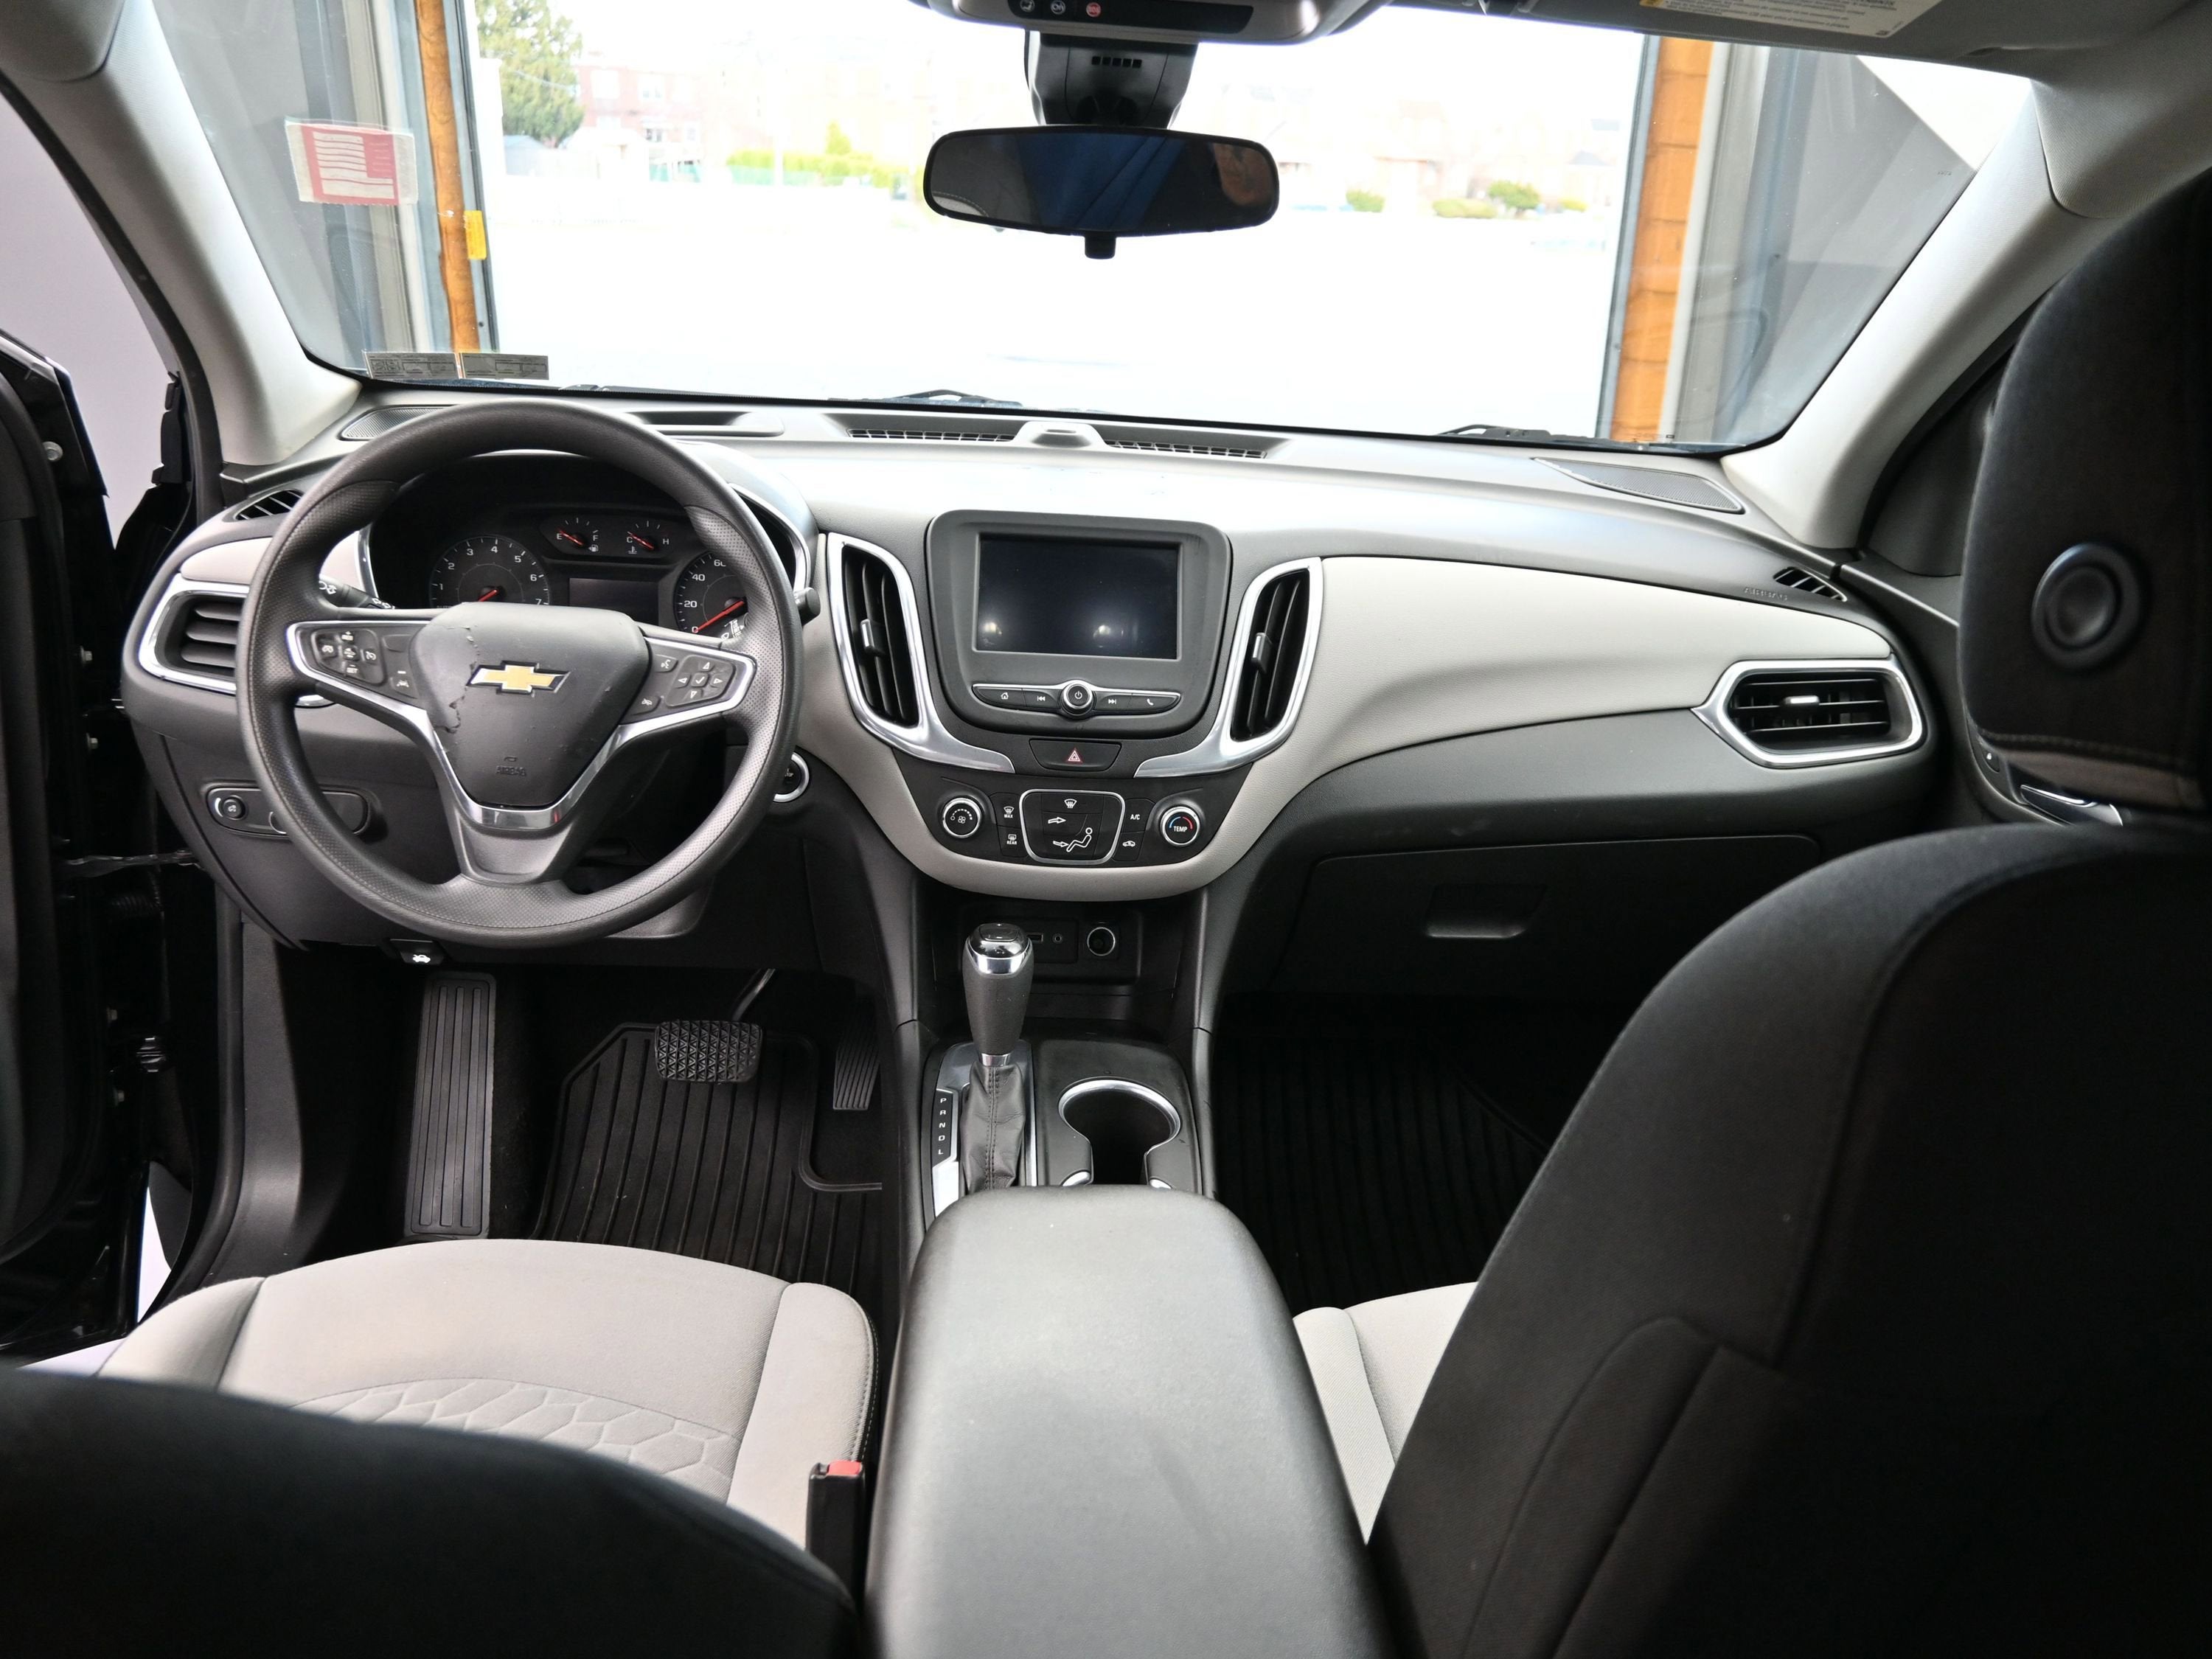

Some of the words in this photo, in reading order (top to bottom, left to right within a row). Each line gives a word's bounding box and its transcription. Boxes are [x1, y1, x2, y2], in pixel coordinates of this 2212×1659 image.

[466, 548, 474, 556] 3
[514, 555, 522, 563] 5
[530, 574, 538, 582] 6
[535, 598, 543, 606] 7
